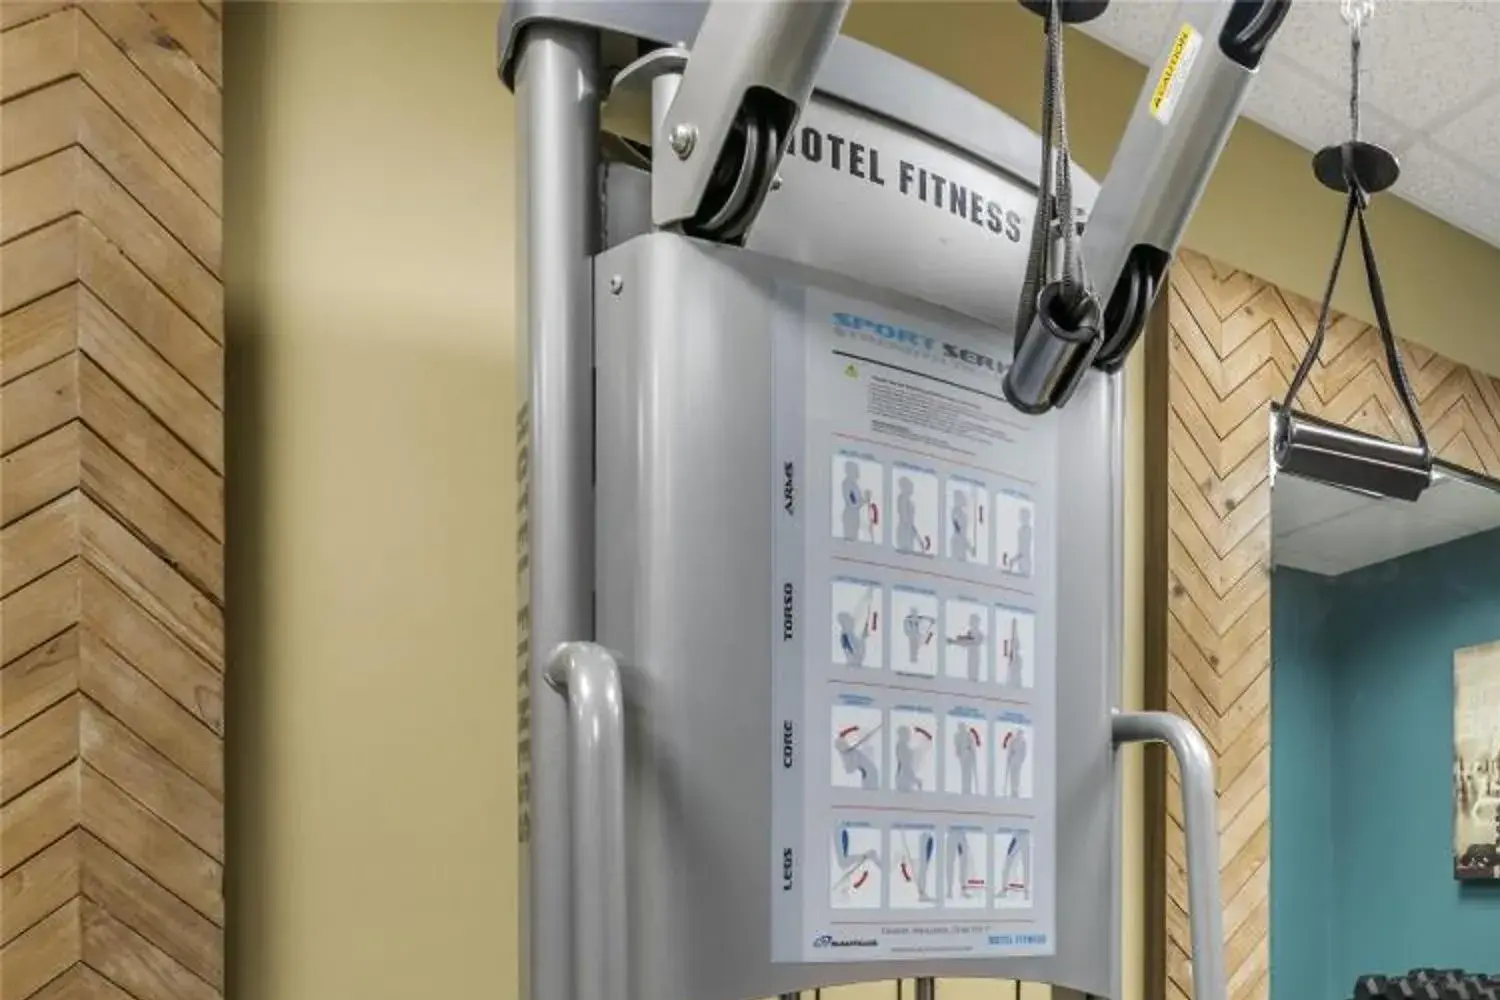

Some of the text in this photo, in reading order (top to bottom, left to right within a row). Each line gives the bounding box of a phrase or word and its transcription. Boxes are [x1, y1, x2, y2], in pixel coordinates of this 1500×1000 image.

[899, 160, 1022, 243] FITNESS
[783, 461, 794, 516] ARMS
[783, 582, 794, 641] TORSO
[783, 720, 793, 768] CORE
[783, 847, 793, 890] LEGS
